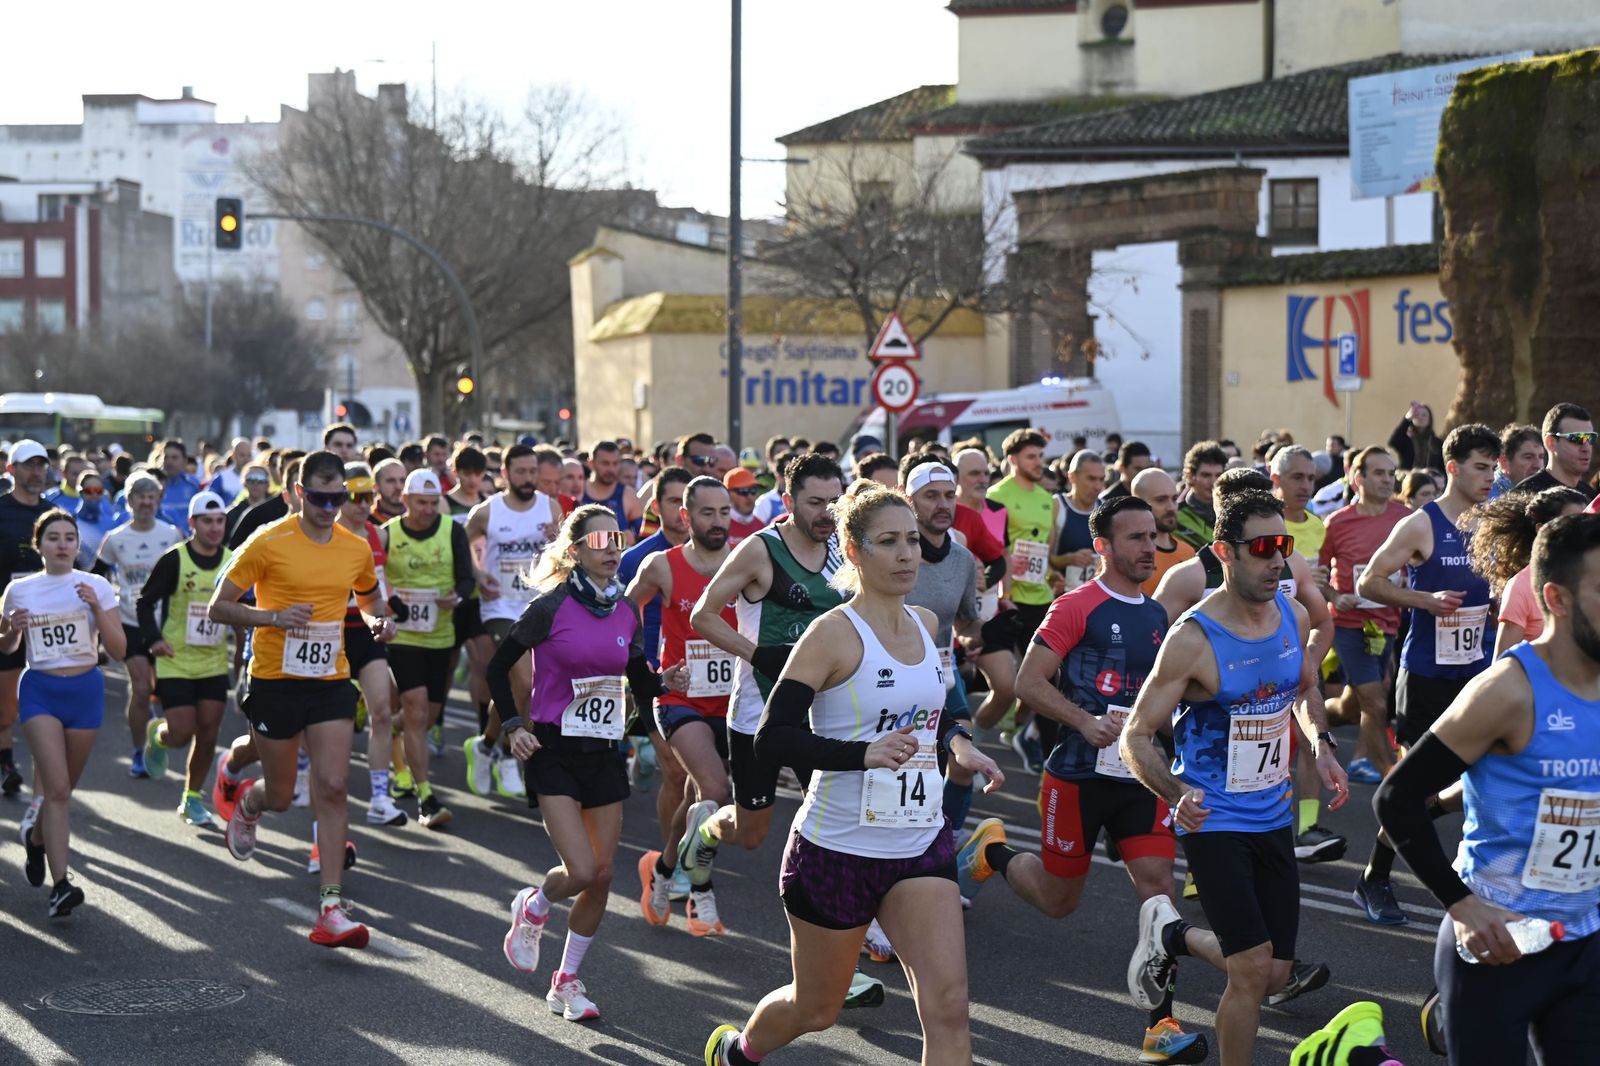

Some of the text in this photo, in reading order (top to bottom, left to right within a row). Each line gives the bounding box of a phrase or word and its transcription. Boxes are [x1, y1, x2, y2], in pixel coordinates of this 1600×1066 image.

[1393, 288, 1454, 345] fes
[1341, 338, 1354, 363] P
[883, 379, 909, 397] 20
[41, 623, 79, 648] 592
[1451, 626, 1481, 652] 196
[296, 641, 333, 665] 483
[707, 659, 732, 684] 66
[574, 697, 615, 725] 482
[1235, 720, 1264, 741] XLII
[1257, 737, 1282, 774] 74
[896, 771, 926, 807] 14
[1542, 796, 1584, 827] XLII
